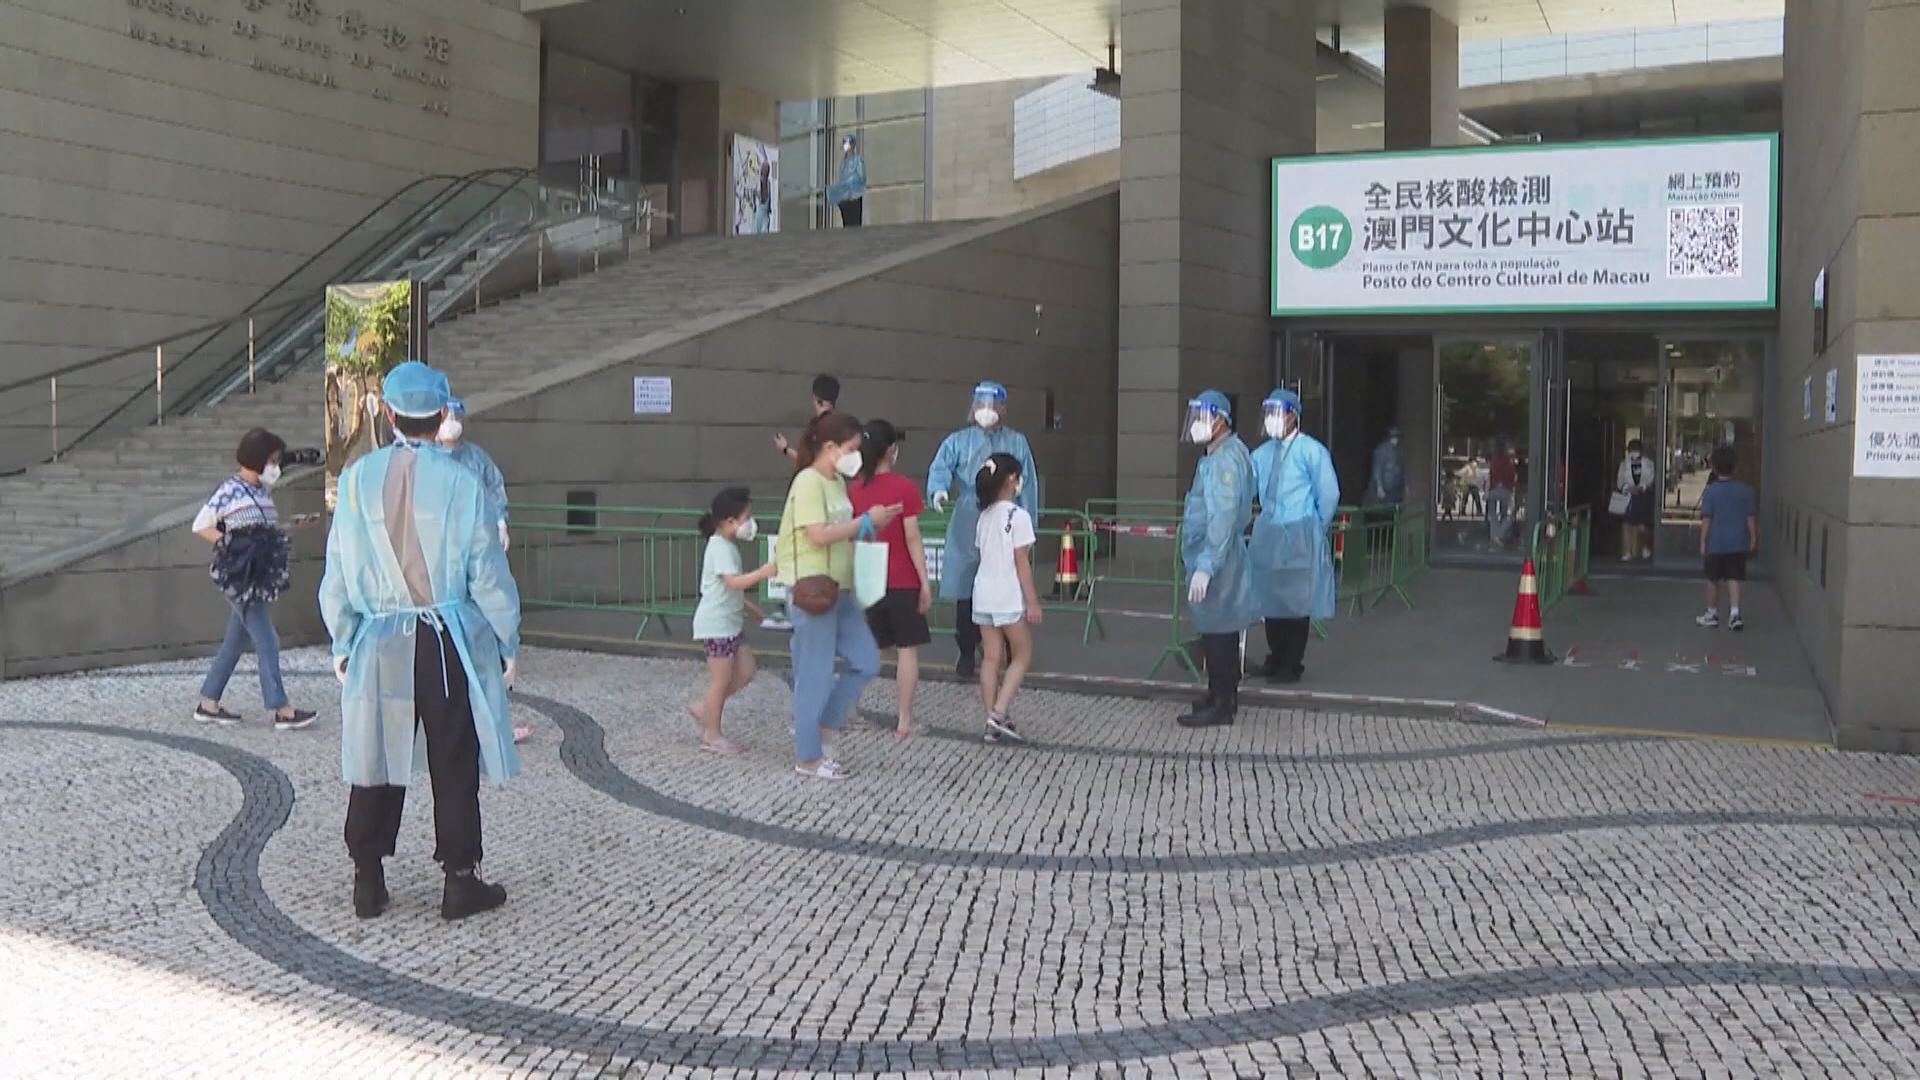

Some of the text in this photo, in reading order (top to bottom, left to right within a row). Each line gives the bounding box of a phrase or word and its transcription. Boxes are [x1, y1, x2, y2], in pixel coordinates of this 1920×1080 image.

[1364, 175, 1551, 211] 全民核酸檢測
[1667, 171, 1741, 191] 網上預約
[1298, 223, 1343, 251] B17
[1363, 207, 1635, 251] 澳門文化中心站
[1362, 257, 1560, 273] Plano de TAN para toda a população
[1362, 269, 1651, 289] Posto do Centro Cultural de Macau
